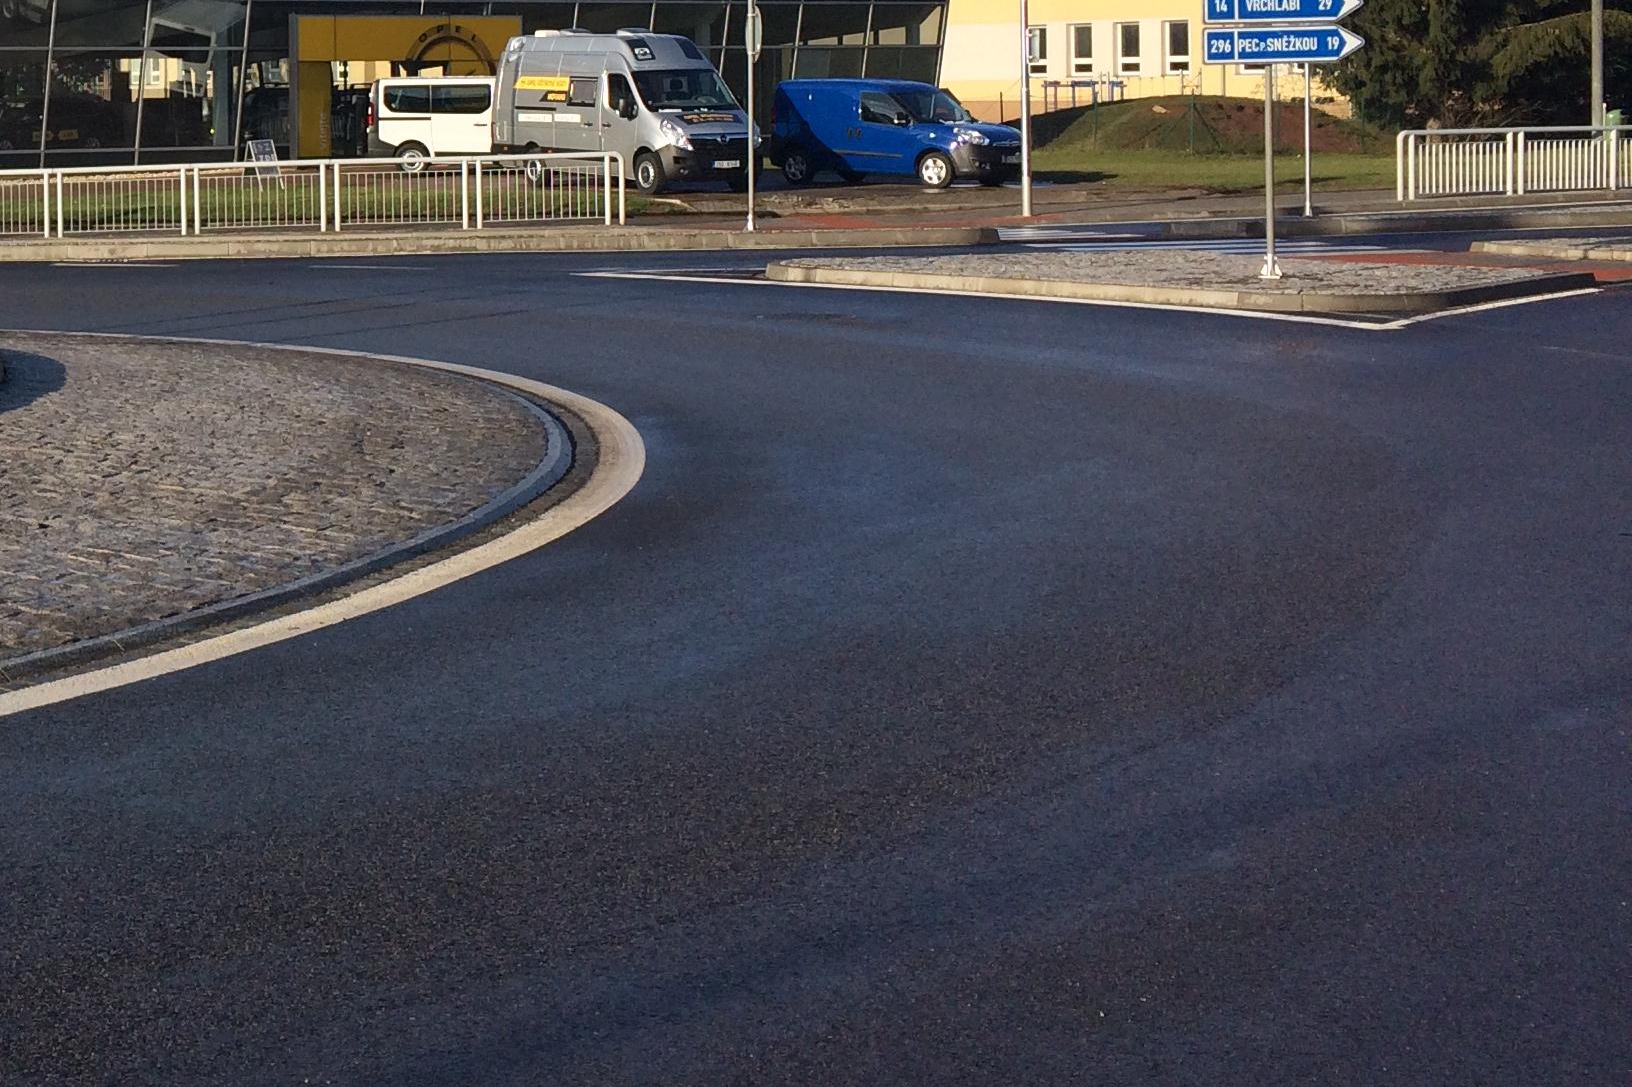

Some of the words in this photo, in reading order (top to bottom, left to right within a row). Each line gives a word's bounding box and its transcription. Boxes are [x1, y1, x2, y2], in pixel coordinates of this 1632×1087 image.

[418, 24, 478, 43] OPEL
[1210, 39, 1232, 54] 296
[1327, 36, 1340, 50] 19
